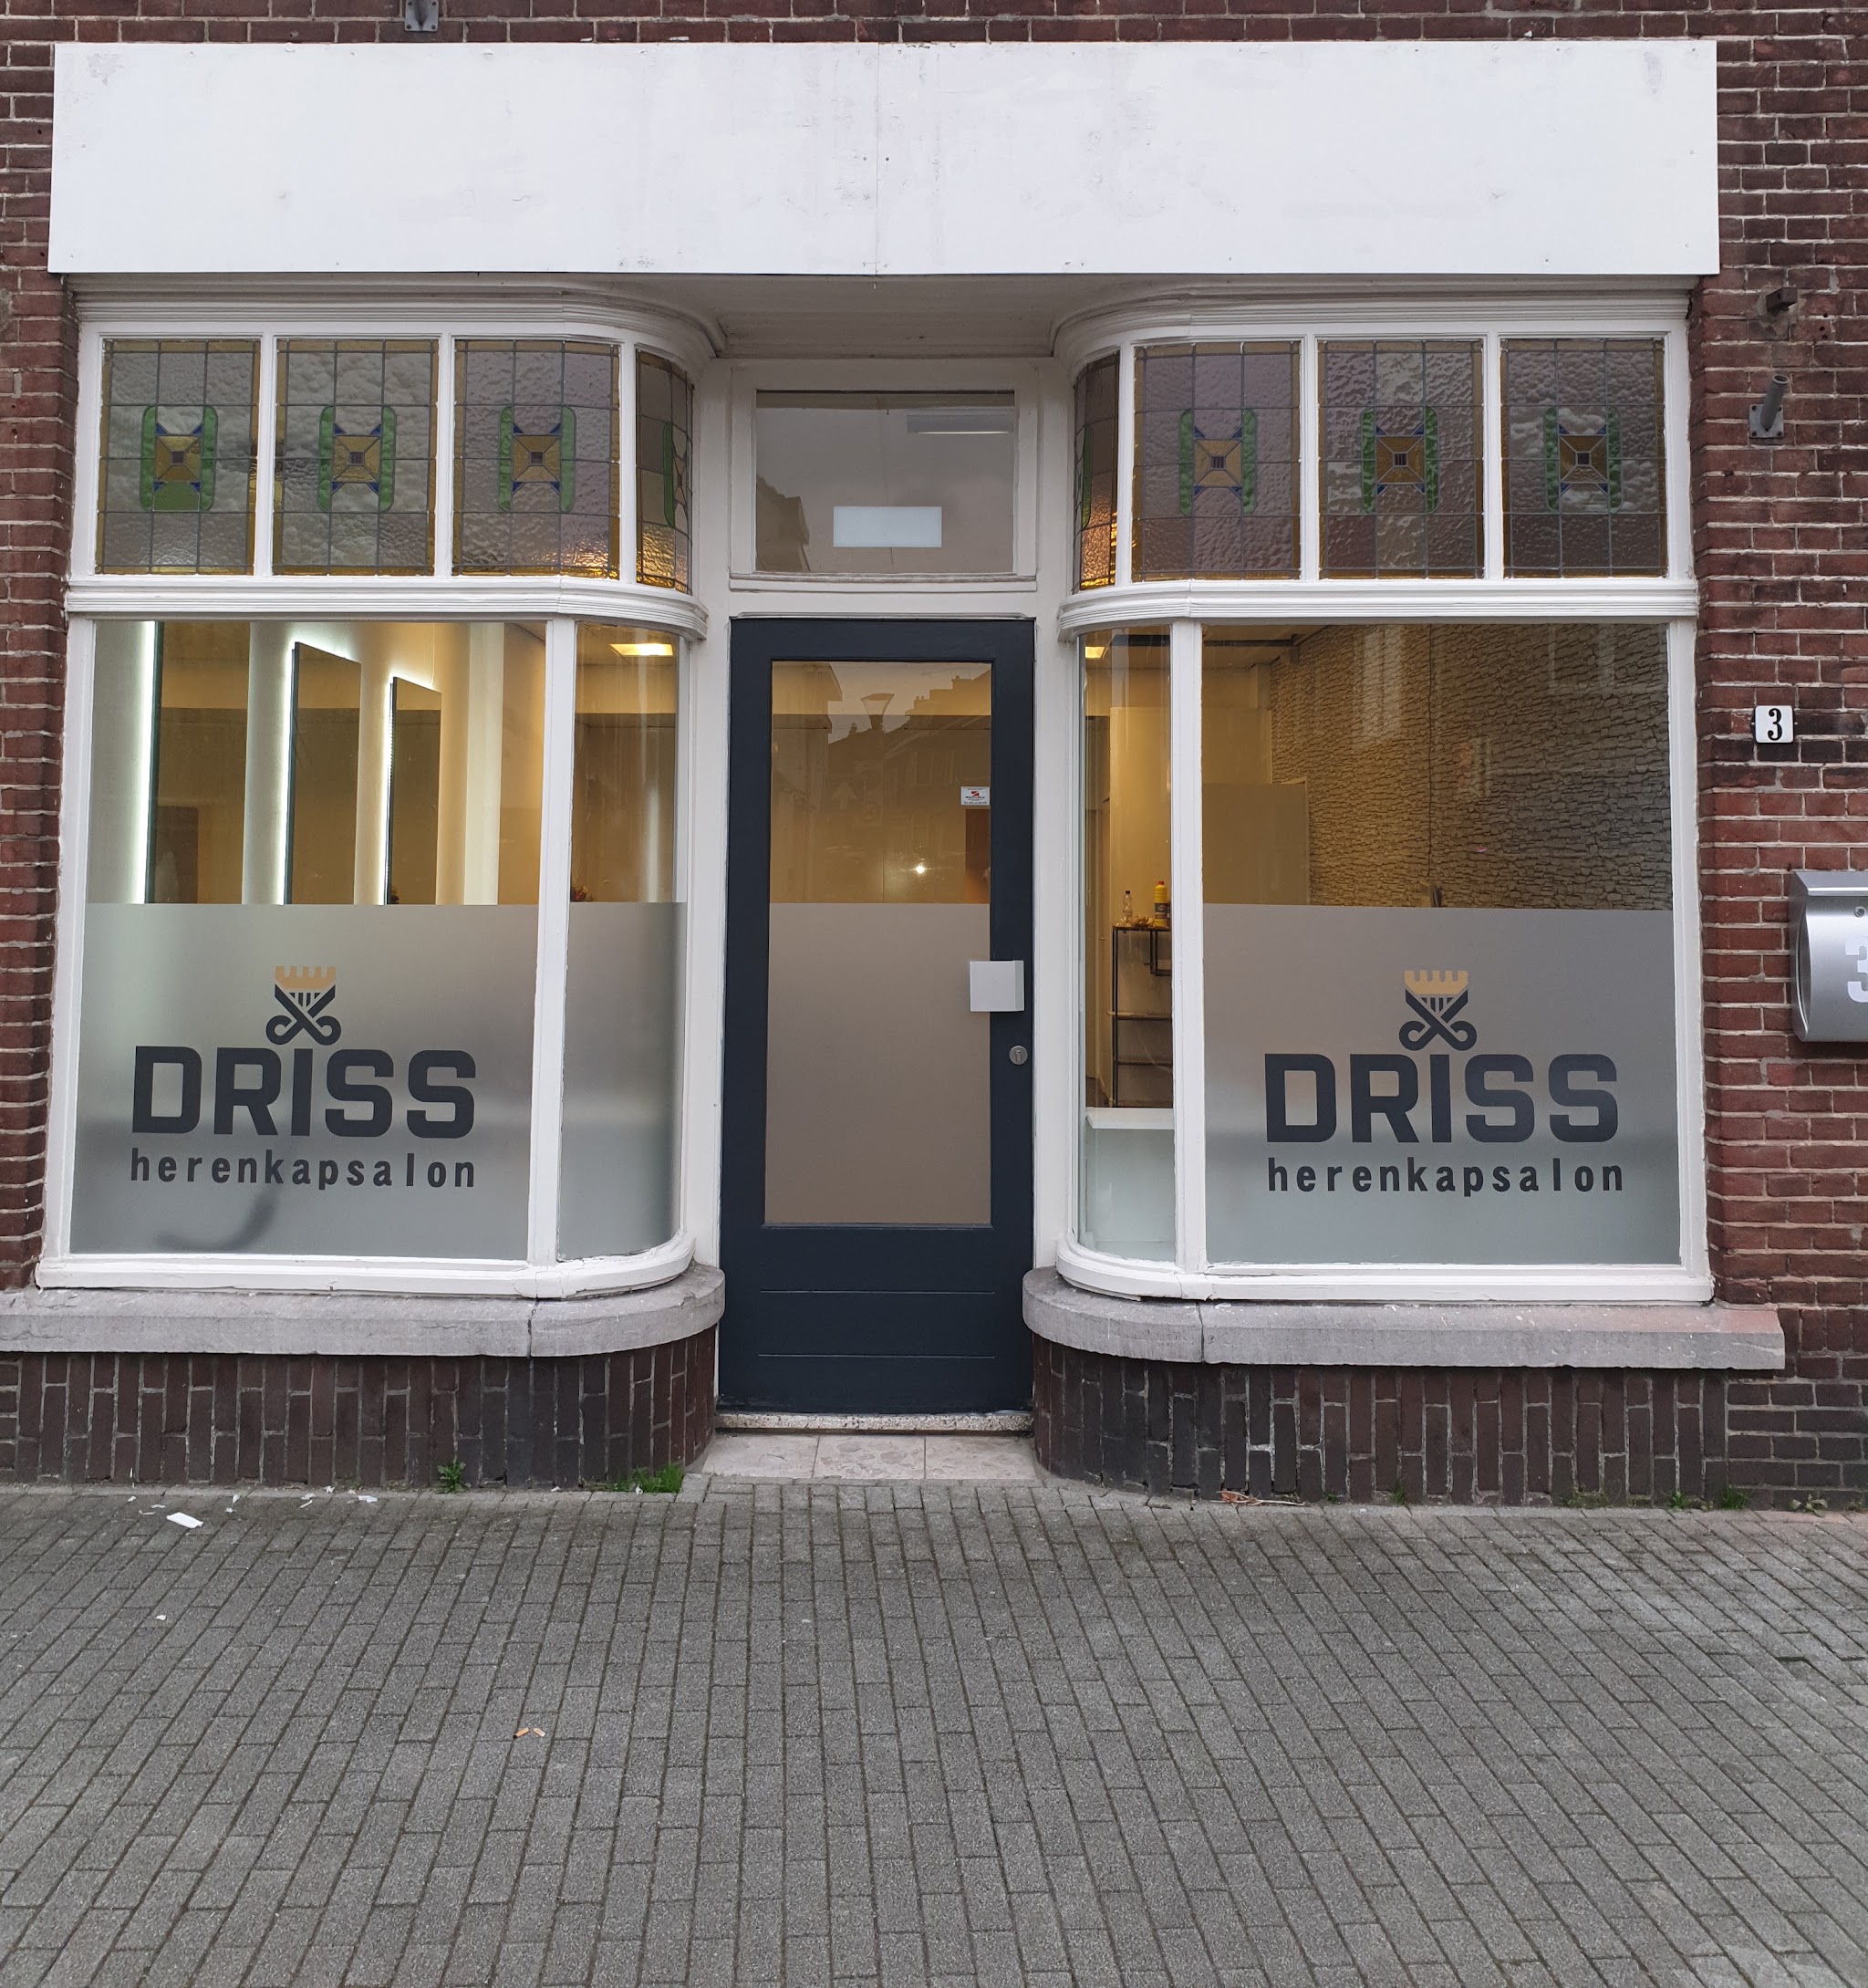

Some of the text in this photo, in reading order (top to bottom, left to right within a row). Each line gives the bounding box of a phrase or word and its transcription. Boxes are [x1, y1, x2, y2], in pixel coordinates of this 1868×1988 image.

[1768, 708, 1782, 741] 3
[132, 1046, 476, 1139] DRISS
[1265, 1053, 1618, 1142] DRISS
[130, 1148, 474, 1190] herenkapsalon
[1268, 1157, 1623, 1197] herenkapsalon
